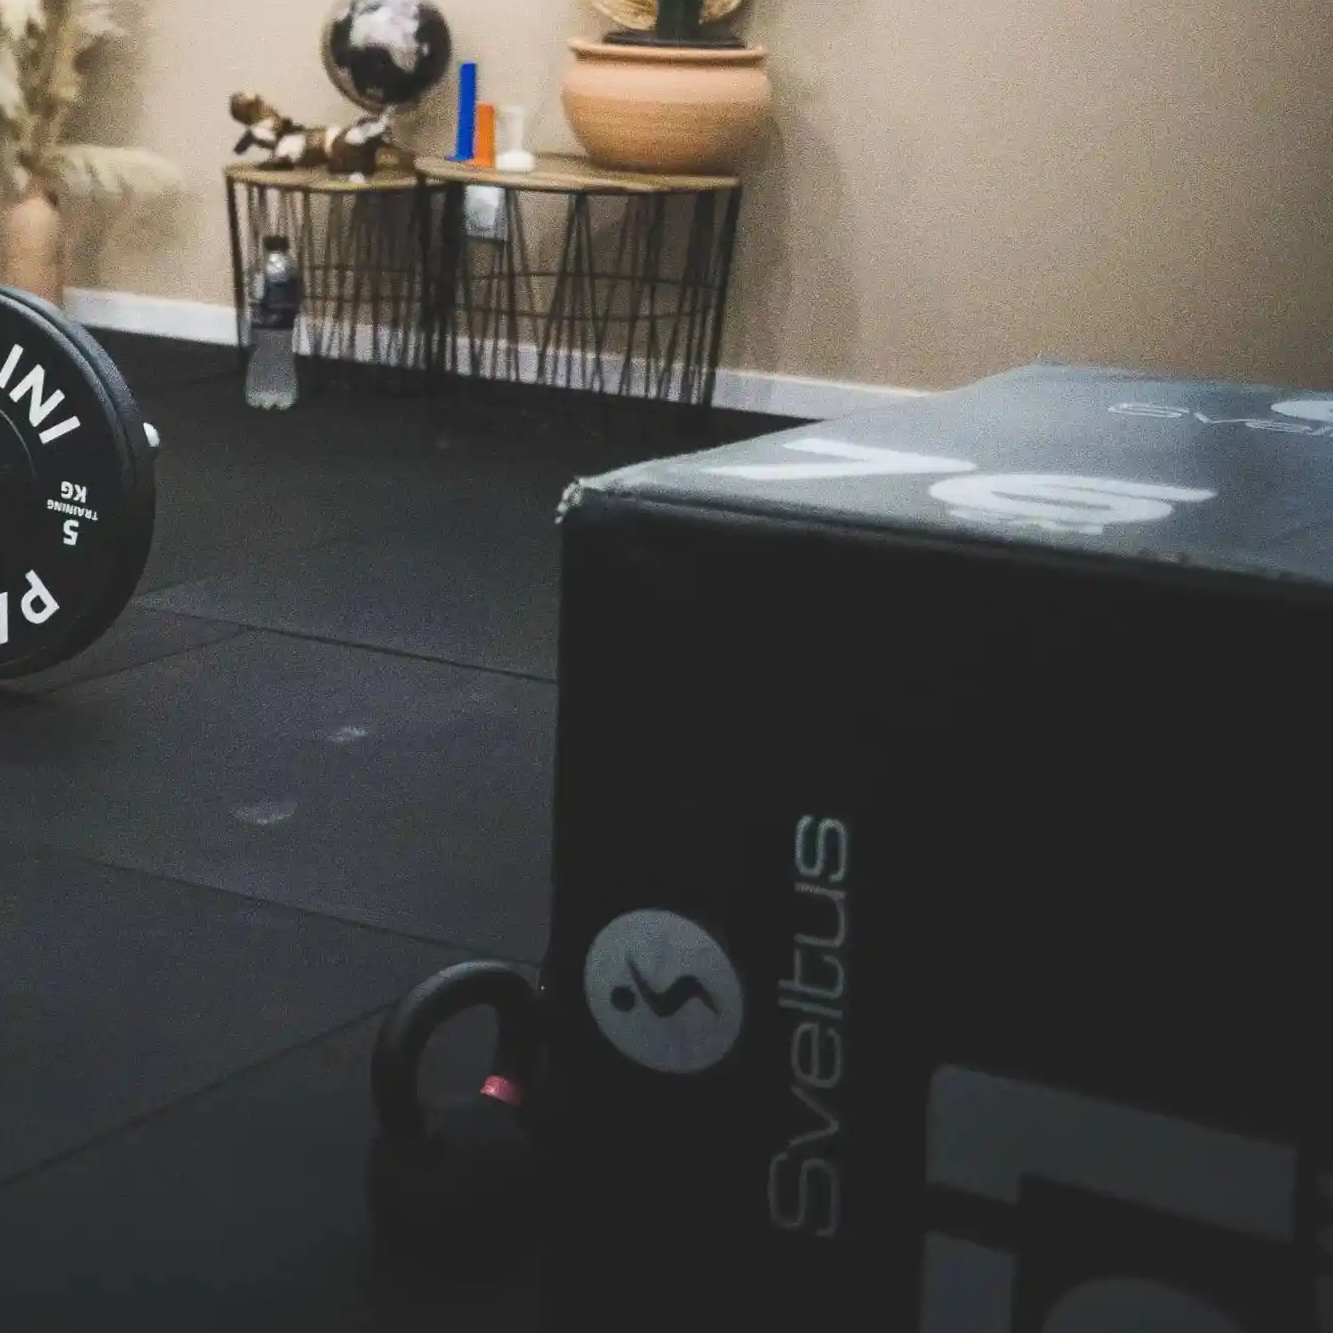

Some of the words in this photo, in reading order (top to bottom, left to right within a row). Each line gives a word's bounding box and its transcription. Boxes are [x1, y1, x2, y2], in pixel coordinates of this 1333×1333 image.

[60, 480, 88, 504] KG
[46, 498, 99, 521] TRAINING
[62, 519, 79, 546] 5
[768, 812, 851, 1239] Sveltus
